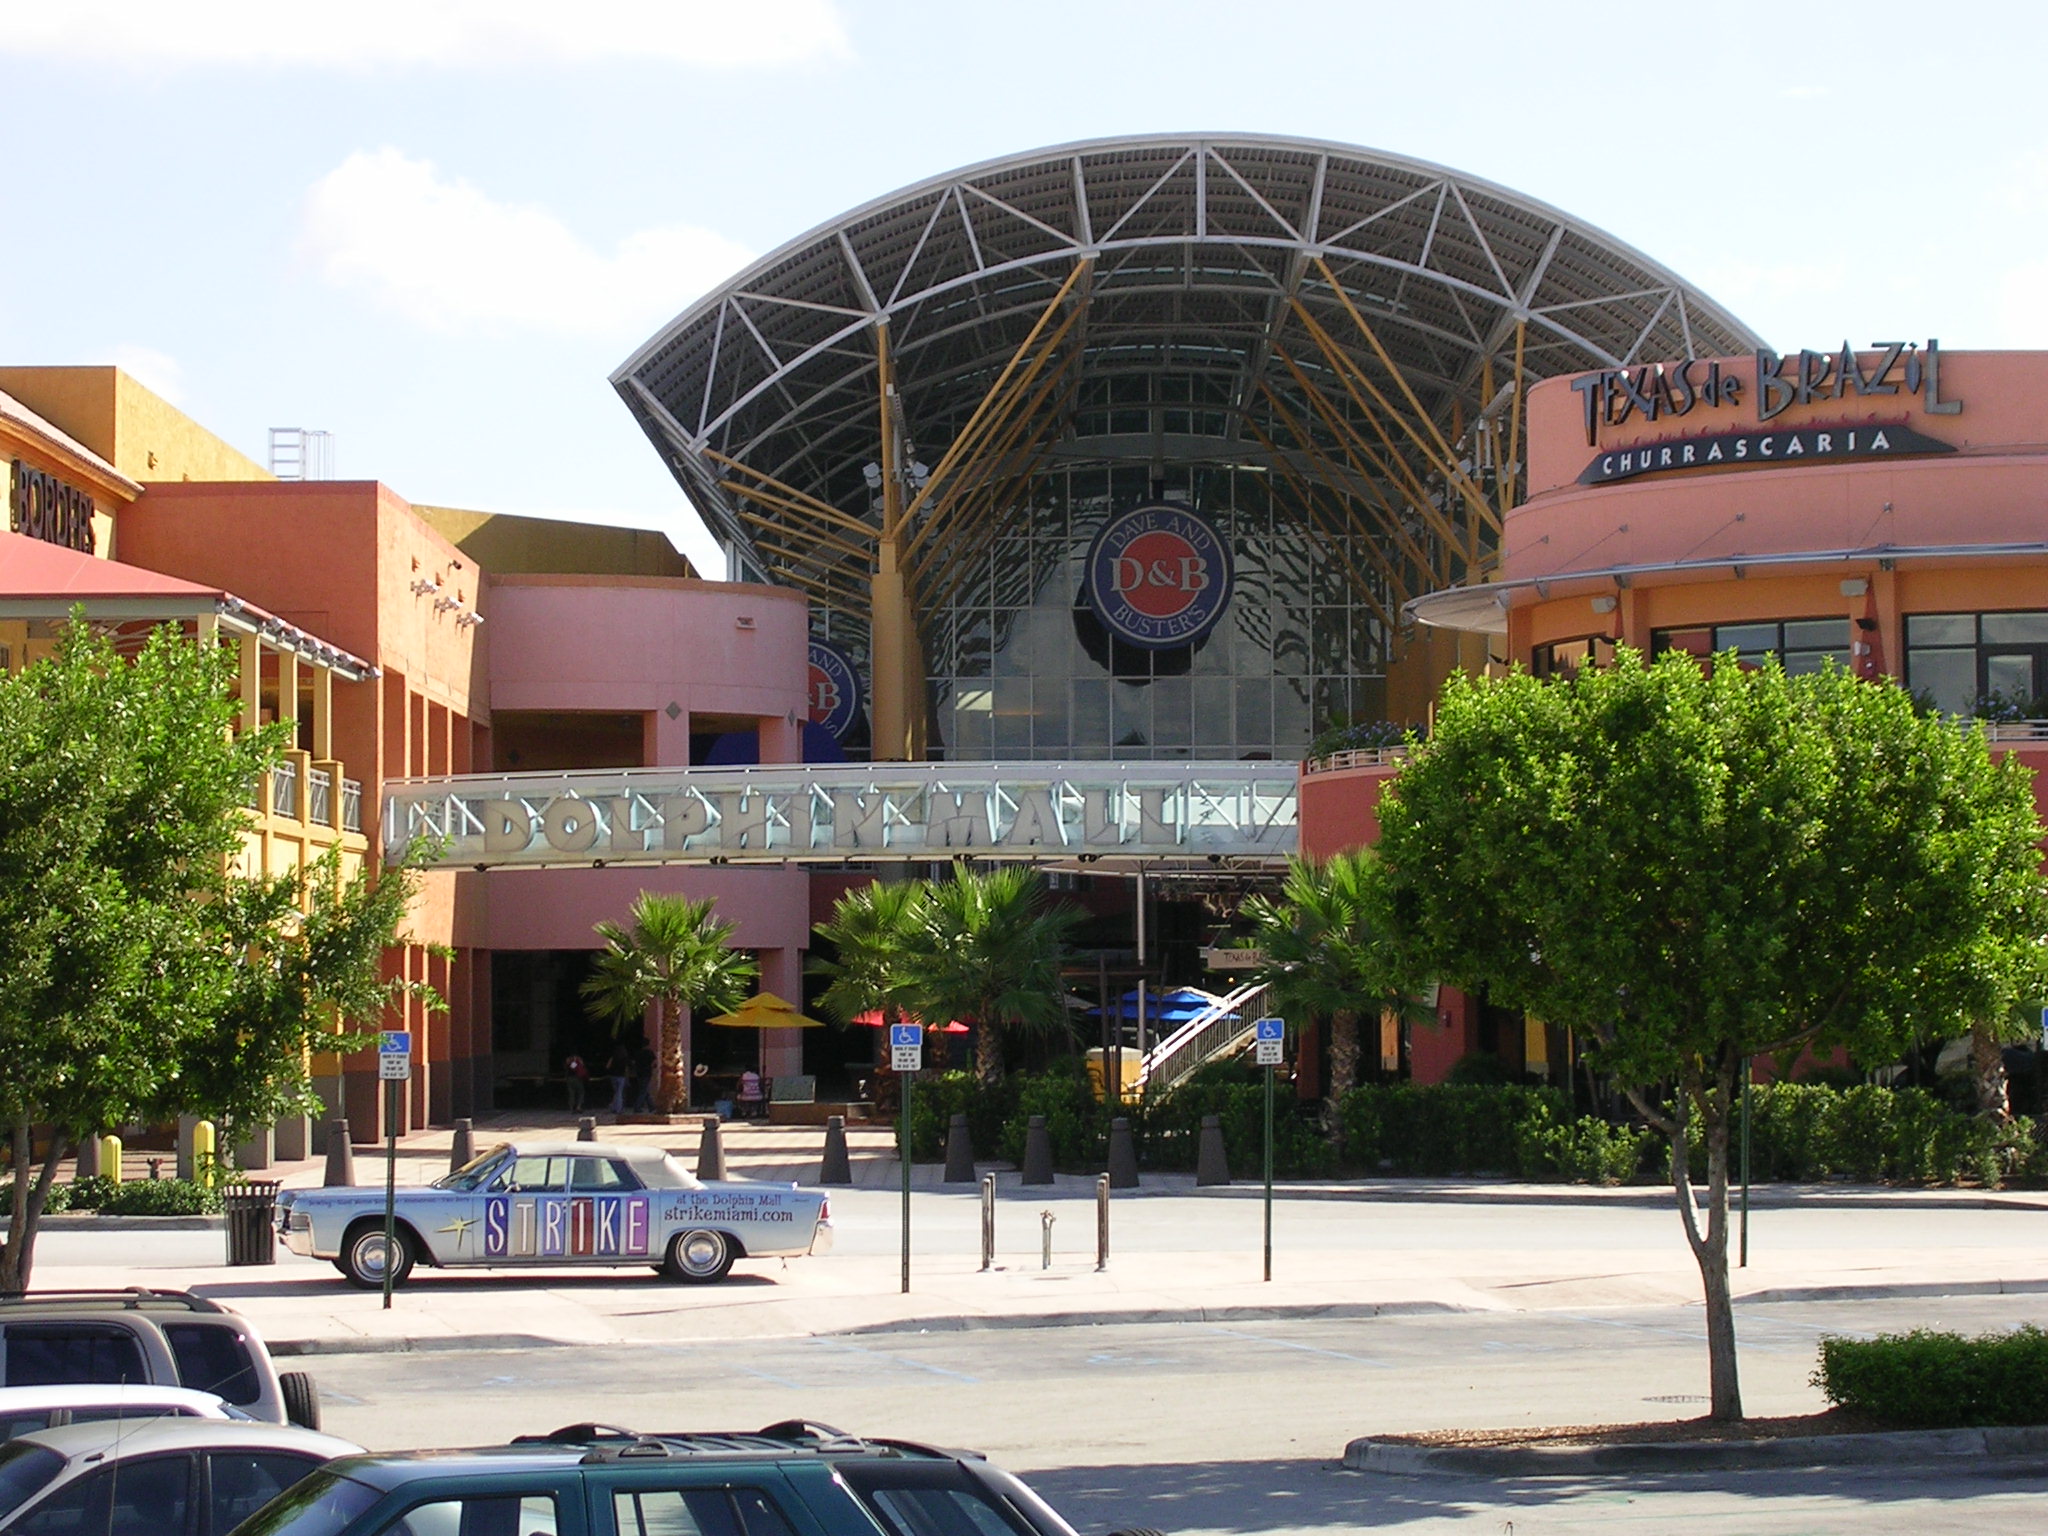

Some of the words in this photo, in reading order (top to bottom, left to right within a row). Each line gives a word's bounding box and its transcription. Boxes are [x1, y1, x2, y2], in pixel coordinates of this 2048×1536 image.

[1570, 358, 1697, 447] TEXAS
[1701, 360, 1743, 408] de
[1602, 429, 1891, 476] CHURRASCARIA
[10, 459, 96, 556] BORDERS
[1108, 512, 1159, 550] DAVE
[1165, 515, 1211, 550] AND
[1108, 556, 1210, 592] D&B
[1112, 603, 1207, 637] BUSTER'S
[808, 647, 843, 678] AND
[484, 792, 890, 853] DOLPHIN
[926, 787, 1181, 847] MALL
[664, 1205, 794, 1222] strikemiami.com
[676, 1194, 687, 1205] at
[691, 1193, 709, 1205] the
[712, 1193, 755, 1209] Dolphin
[758, 1193, 782, 1206] Mall
[487, 1199, 644, 1253] STRIKE
